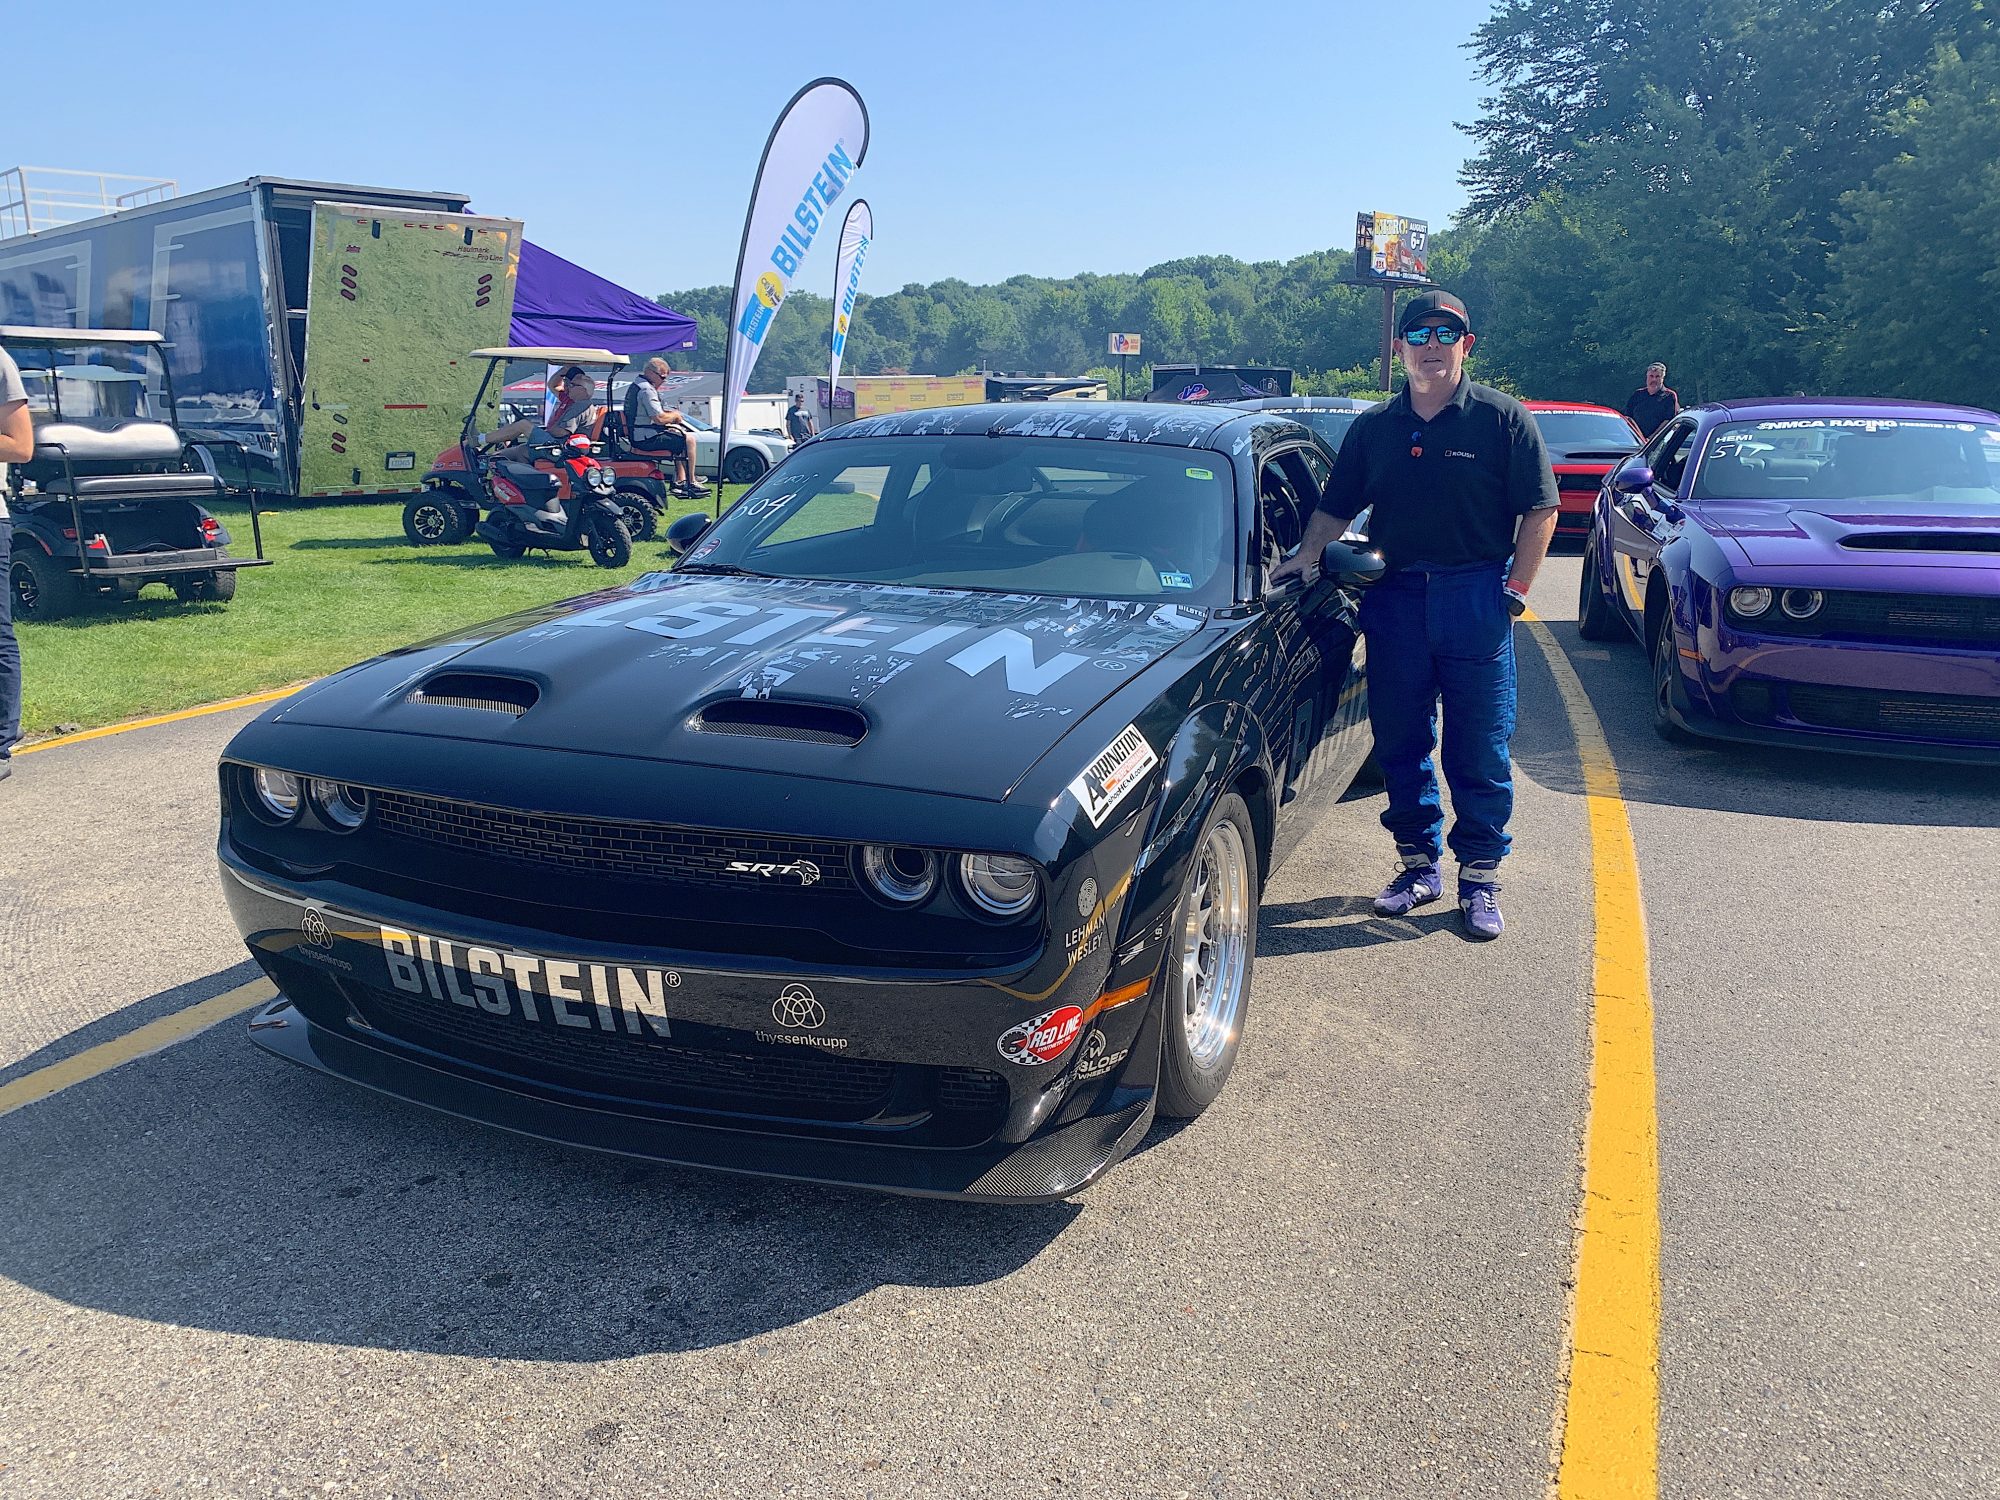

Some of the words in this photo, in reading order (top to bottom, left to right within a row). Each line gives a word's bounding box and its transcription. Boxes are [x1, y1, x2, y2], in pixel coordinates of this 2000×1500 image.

[771, 143, 854, 278] BILSTEIN
[1410, 222, 1427, 233] AUGUST
[1411, 232, 1425, 251] 6-7
[1768, 420, 1825, 430] NMCA
[1829, 419, 1898, 429] RACING
[1715, 434, 1753, 443] HEMI
[1452, 451, 1475, 459] ROUSH
[1163, 575, 1173, 584] 11
[1082, 727, 1142, 811] ARRINGTON
[725, 861, 800, 877] SRT
[1065, 912, 1105, 948] LEHMAN
[298, 943, 352, 972] thyssenkrupp
[1067, 932, 1103, 966] WESLEY
[1029, 1026, 1058, 1049] RED
[1059, 1013, 1082, 1038] LINE
[755, 1031, 848, 1050] thyssenkrupp
[1037, 1039, 1064, 1053] SYNTHETIC
[1078, 1066, 1111, 1080] WHEELS
